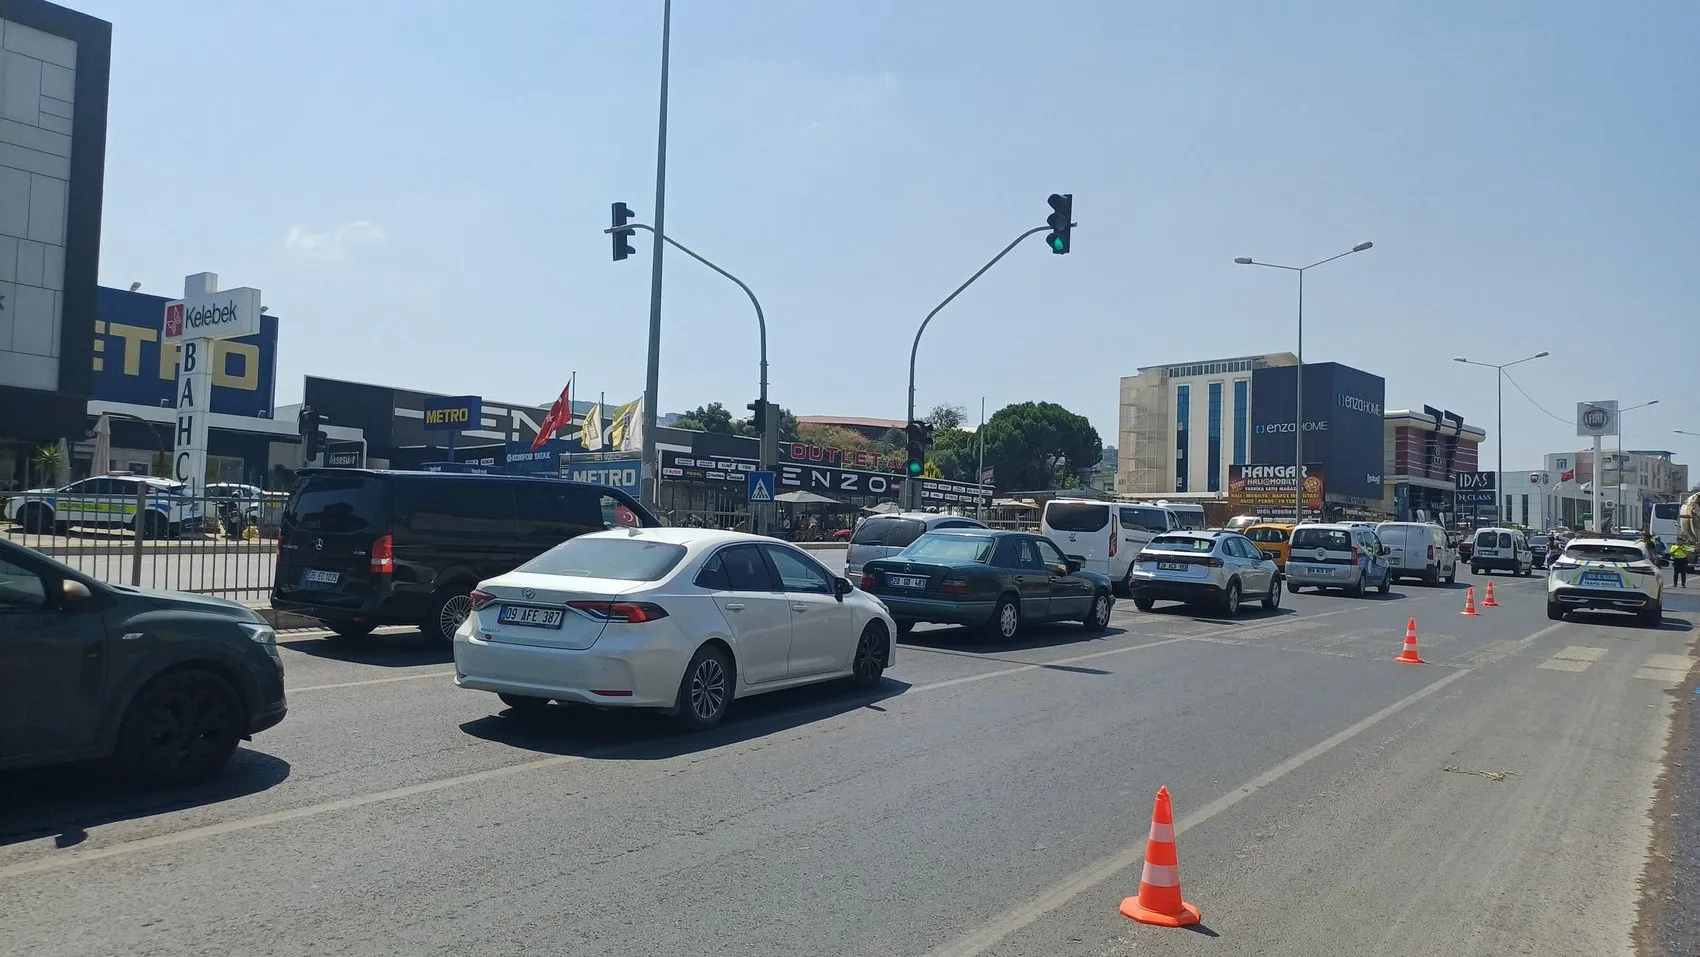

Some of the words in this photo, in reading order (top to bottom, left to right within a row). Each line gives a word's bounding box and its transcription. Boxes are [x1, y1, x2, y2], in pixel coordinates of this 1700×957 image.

[185, 300, 237, 329] Kelebek
[426, 408, 469, 424] METRO
[1266, 422, 1296, 433] enza
[790, 442, 882, 468] OUTLET
[573, 468, 636, 487] METRO
[782, 466, 887, 493] ENZO
[1241, 465, 1308, 479] HANGAR
[1270, 478, 1299, 486] MOBİLY
[506, 607, 518, 620] 09
[521, 609, 539, 622] AFE
[542, 611, 560, 624] 387
